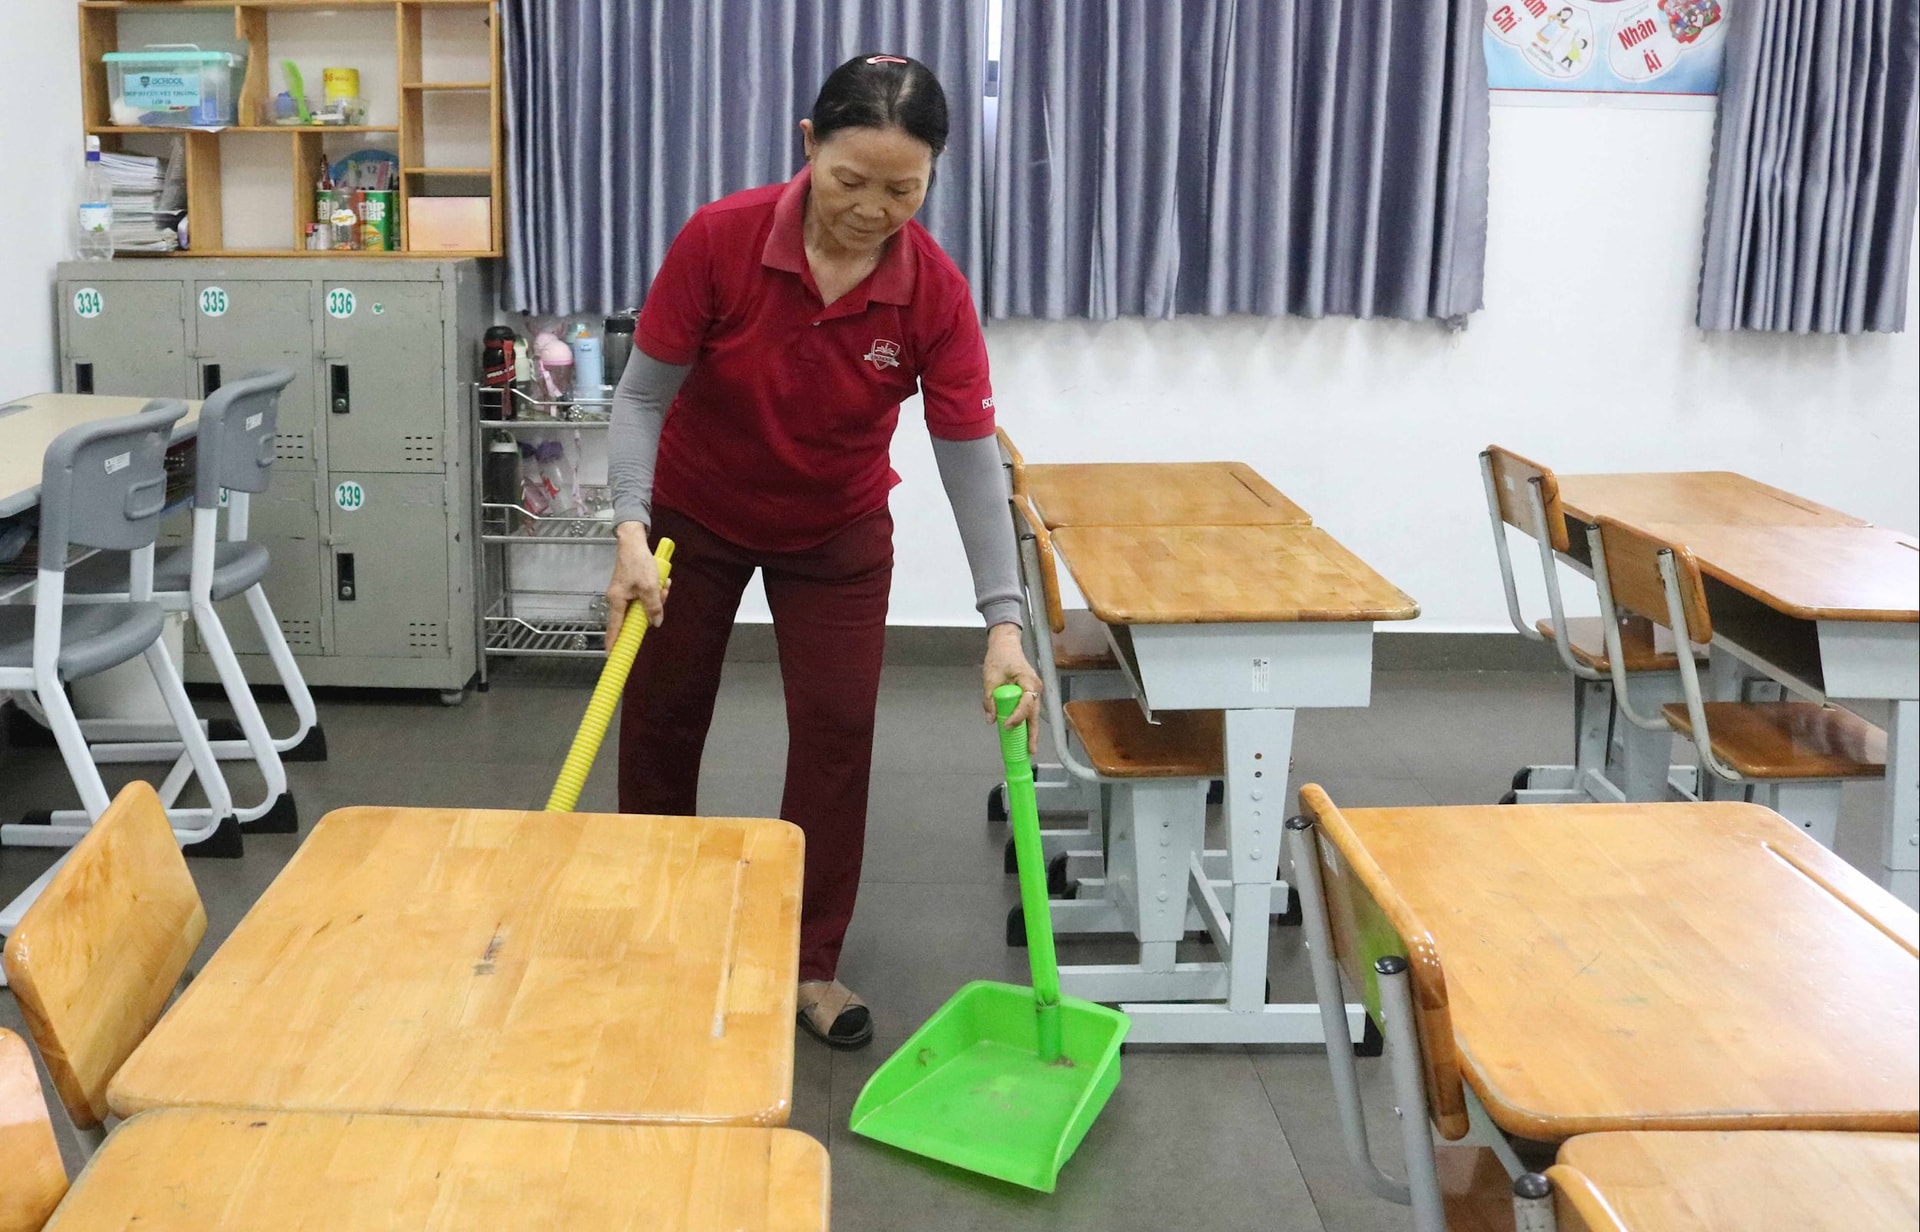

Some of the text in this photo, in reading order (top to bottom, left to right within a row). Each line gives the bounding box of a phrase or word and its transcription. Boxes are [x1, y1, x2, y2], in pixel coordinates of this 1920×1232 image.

[1492, 5, 1522, 34] Chỉ
[1617, 18, 1657, 51] Nhân
[1643, 49, 1663, 73] Ái
[366, 165, 377, 174] 12
[77, 292, 100, 314] 334
[203, 291, 225, 313] 335
[330, 292, 353, 314] 336
[339, 485, 361, 506] 339
